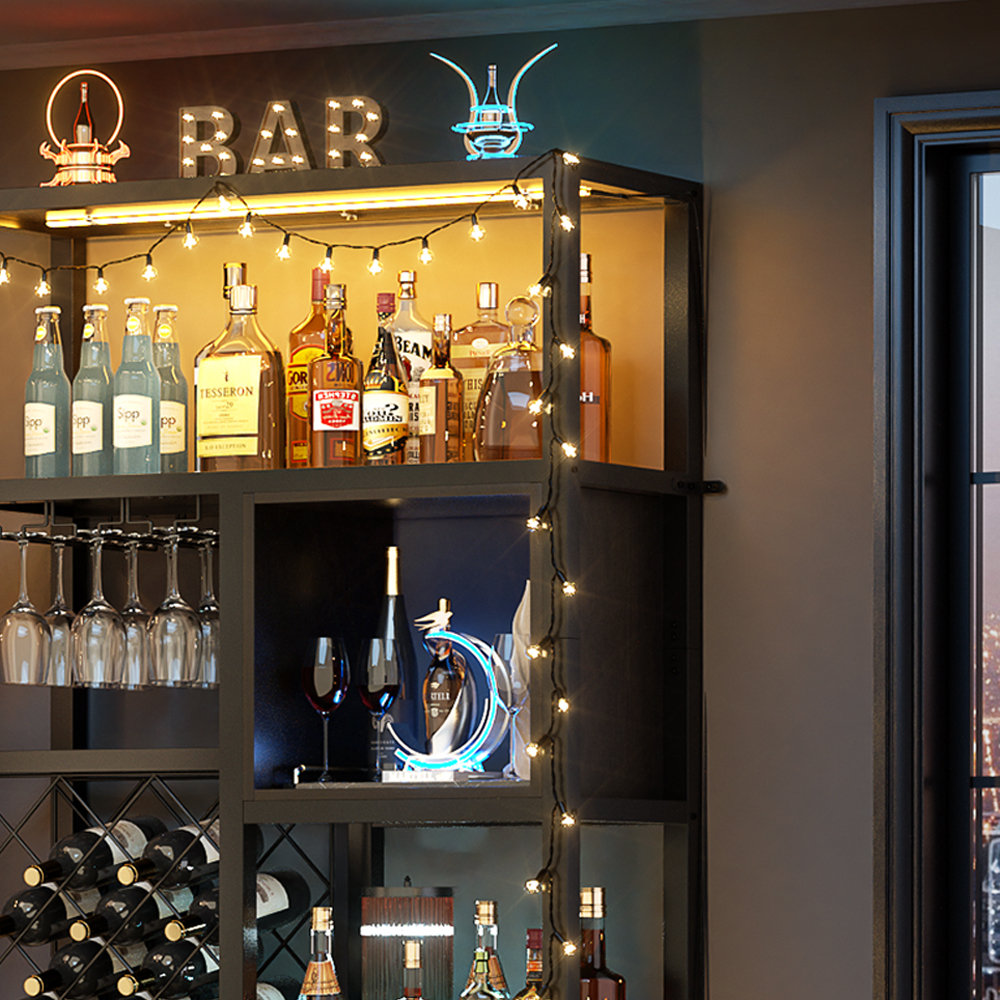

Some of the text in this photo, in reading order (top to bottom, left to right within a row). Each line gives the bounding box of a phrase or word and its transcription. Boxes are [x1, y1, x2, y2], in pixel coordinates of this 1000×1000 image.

[179, 95, 384, 178] BAR
[394, 335, 433, 361] BEAM
[199, 386, 254, 399] TESSERON
